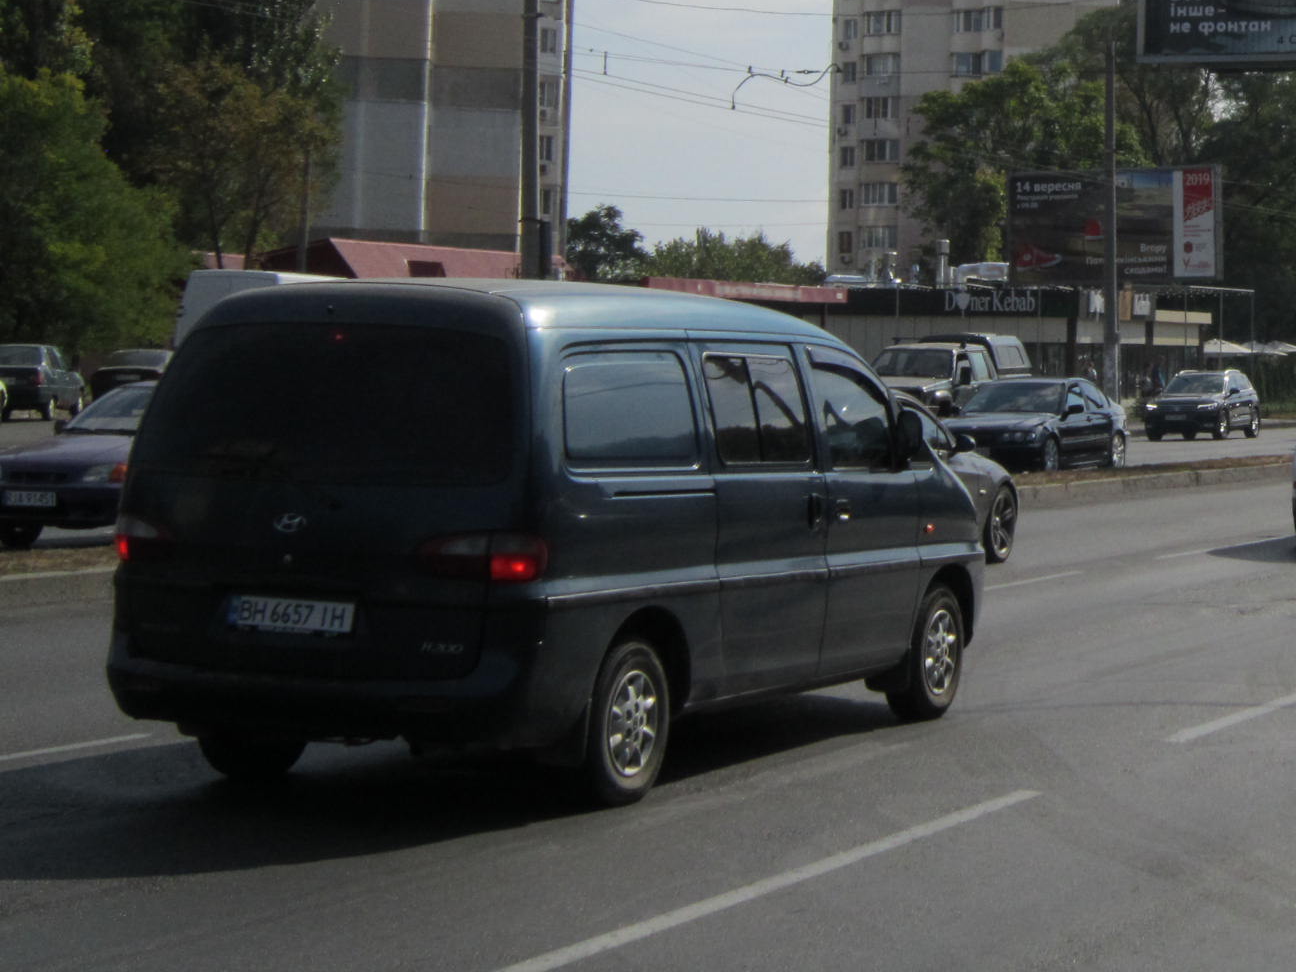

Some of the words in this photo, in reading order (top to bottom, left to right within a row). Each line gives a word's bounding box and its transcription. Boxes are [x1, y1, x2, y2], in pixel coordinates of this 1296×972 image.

[1170, 3, 1215, 17] інше
[1170, 22, 1191, 34] не
[1198, 20, 1271, 36] фонтан
[1185, 171, 1211, 187] 2019
[1016, 181, 1030, 193] 14
[1034, 181, 1082, 194] вересня
[992, 287, 1036, 312] Kebab
[240, 599, 268, 622] BH
[270, 601, 315, 626] 6657
